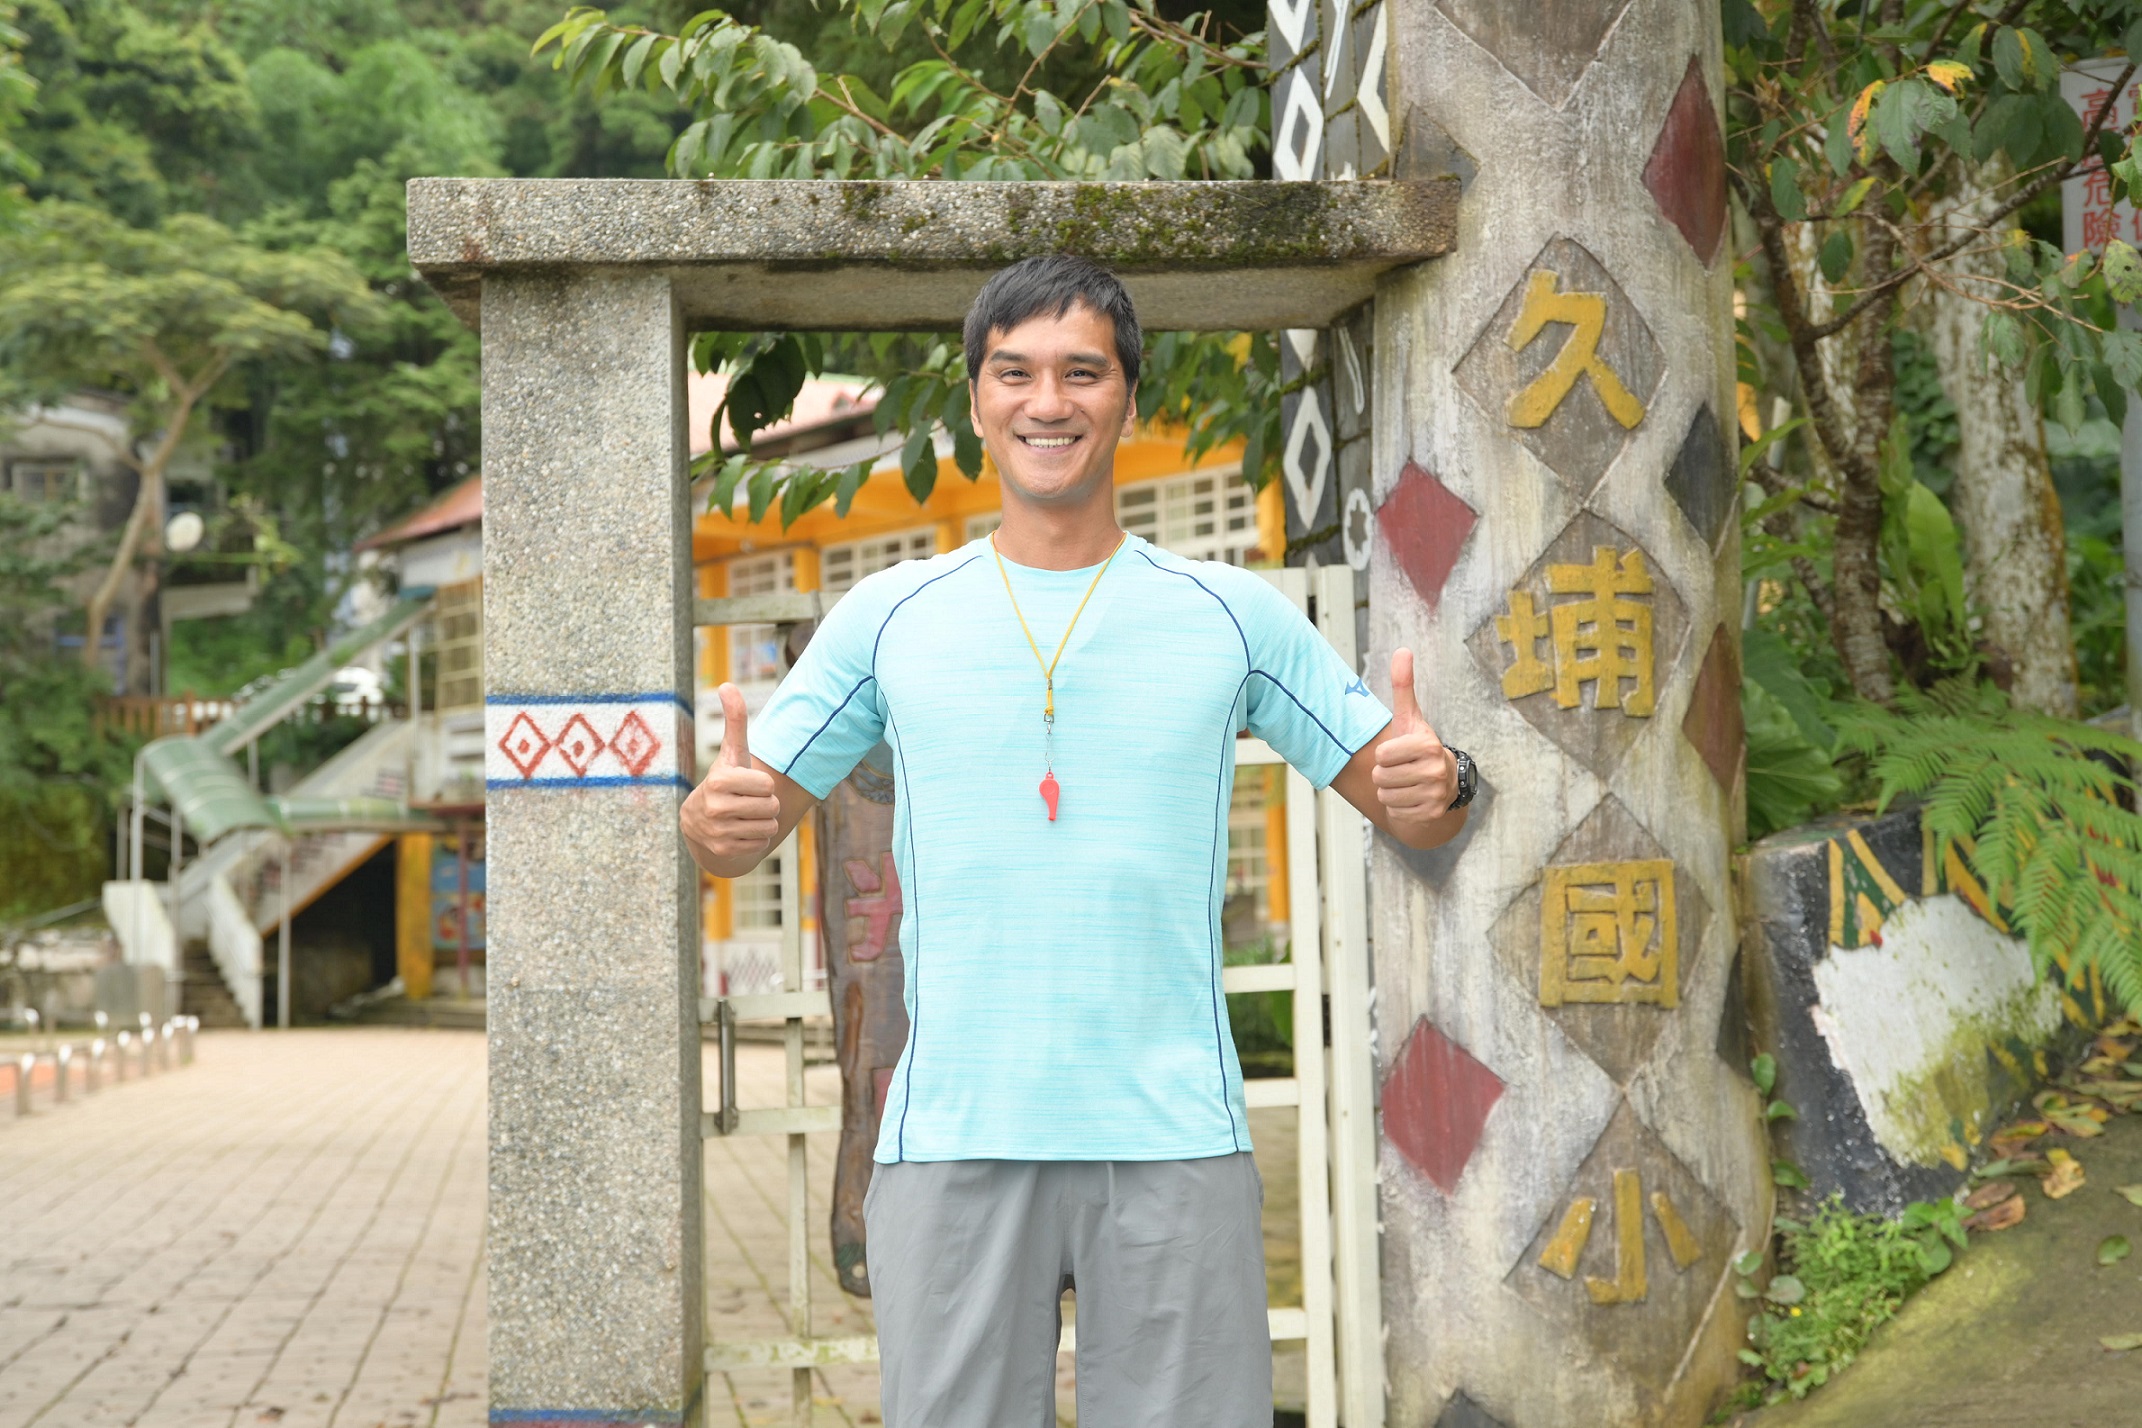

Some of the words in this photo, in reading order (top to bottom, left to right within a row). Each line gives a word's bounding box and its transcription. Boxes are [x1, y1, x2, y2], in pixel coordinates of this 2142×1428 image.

[2080, 88, 2122, 249] 高危險
[1495, 269, 1701, 1304] 久埔國小
